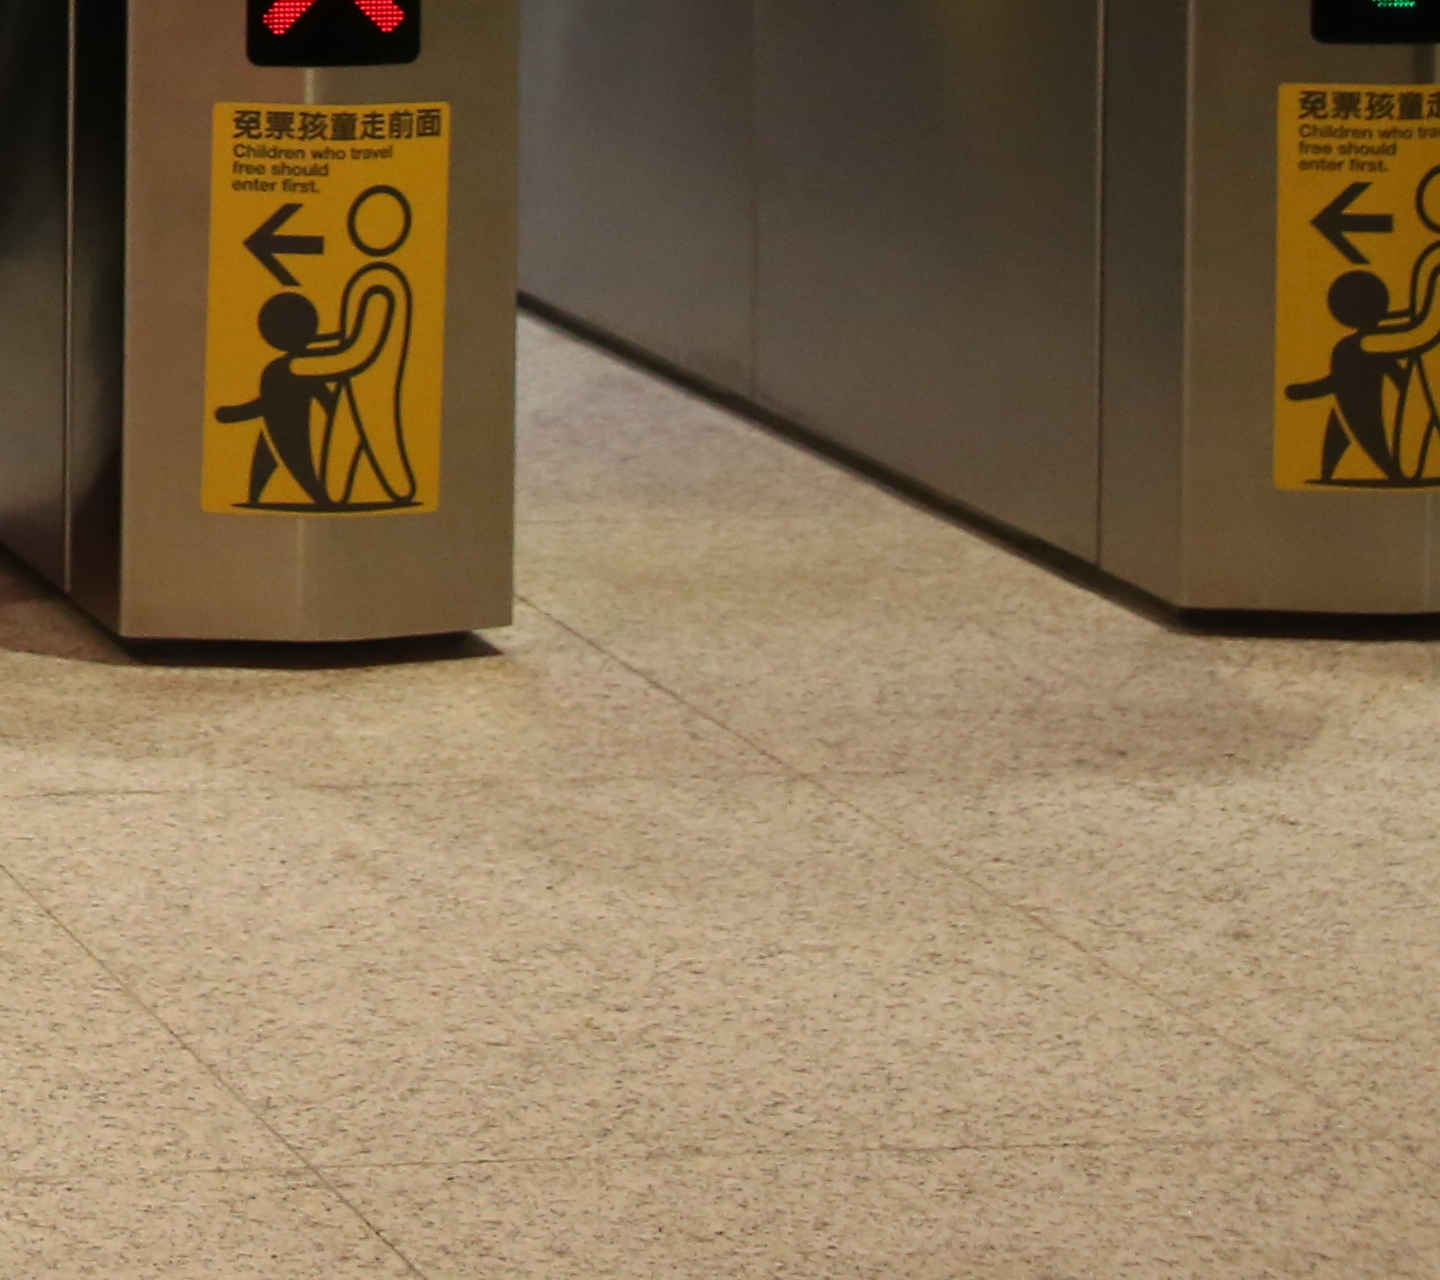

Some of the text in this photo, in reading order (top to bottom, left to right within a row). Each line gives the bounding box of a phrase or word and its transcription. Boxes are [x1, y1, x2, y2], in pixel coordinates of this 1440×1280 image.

[232, 108, 442, 141] 免票孩童走前面
[233, 143, 393, 160] Children who travel
[232, 160, 329, 176] free should
[232, 180, 278, 192] enter
